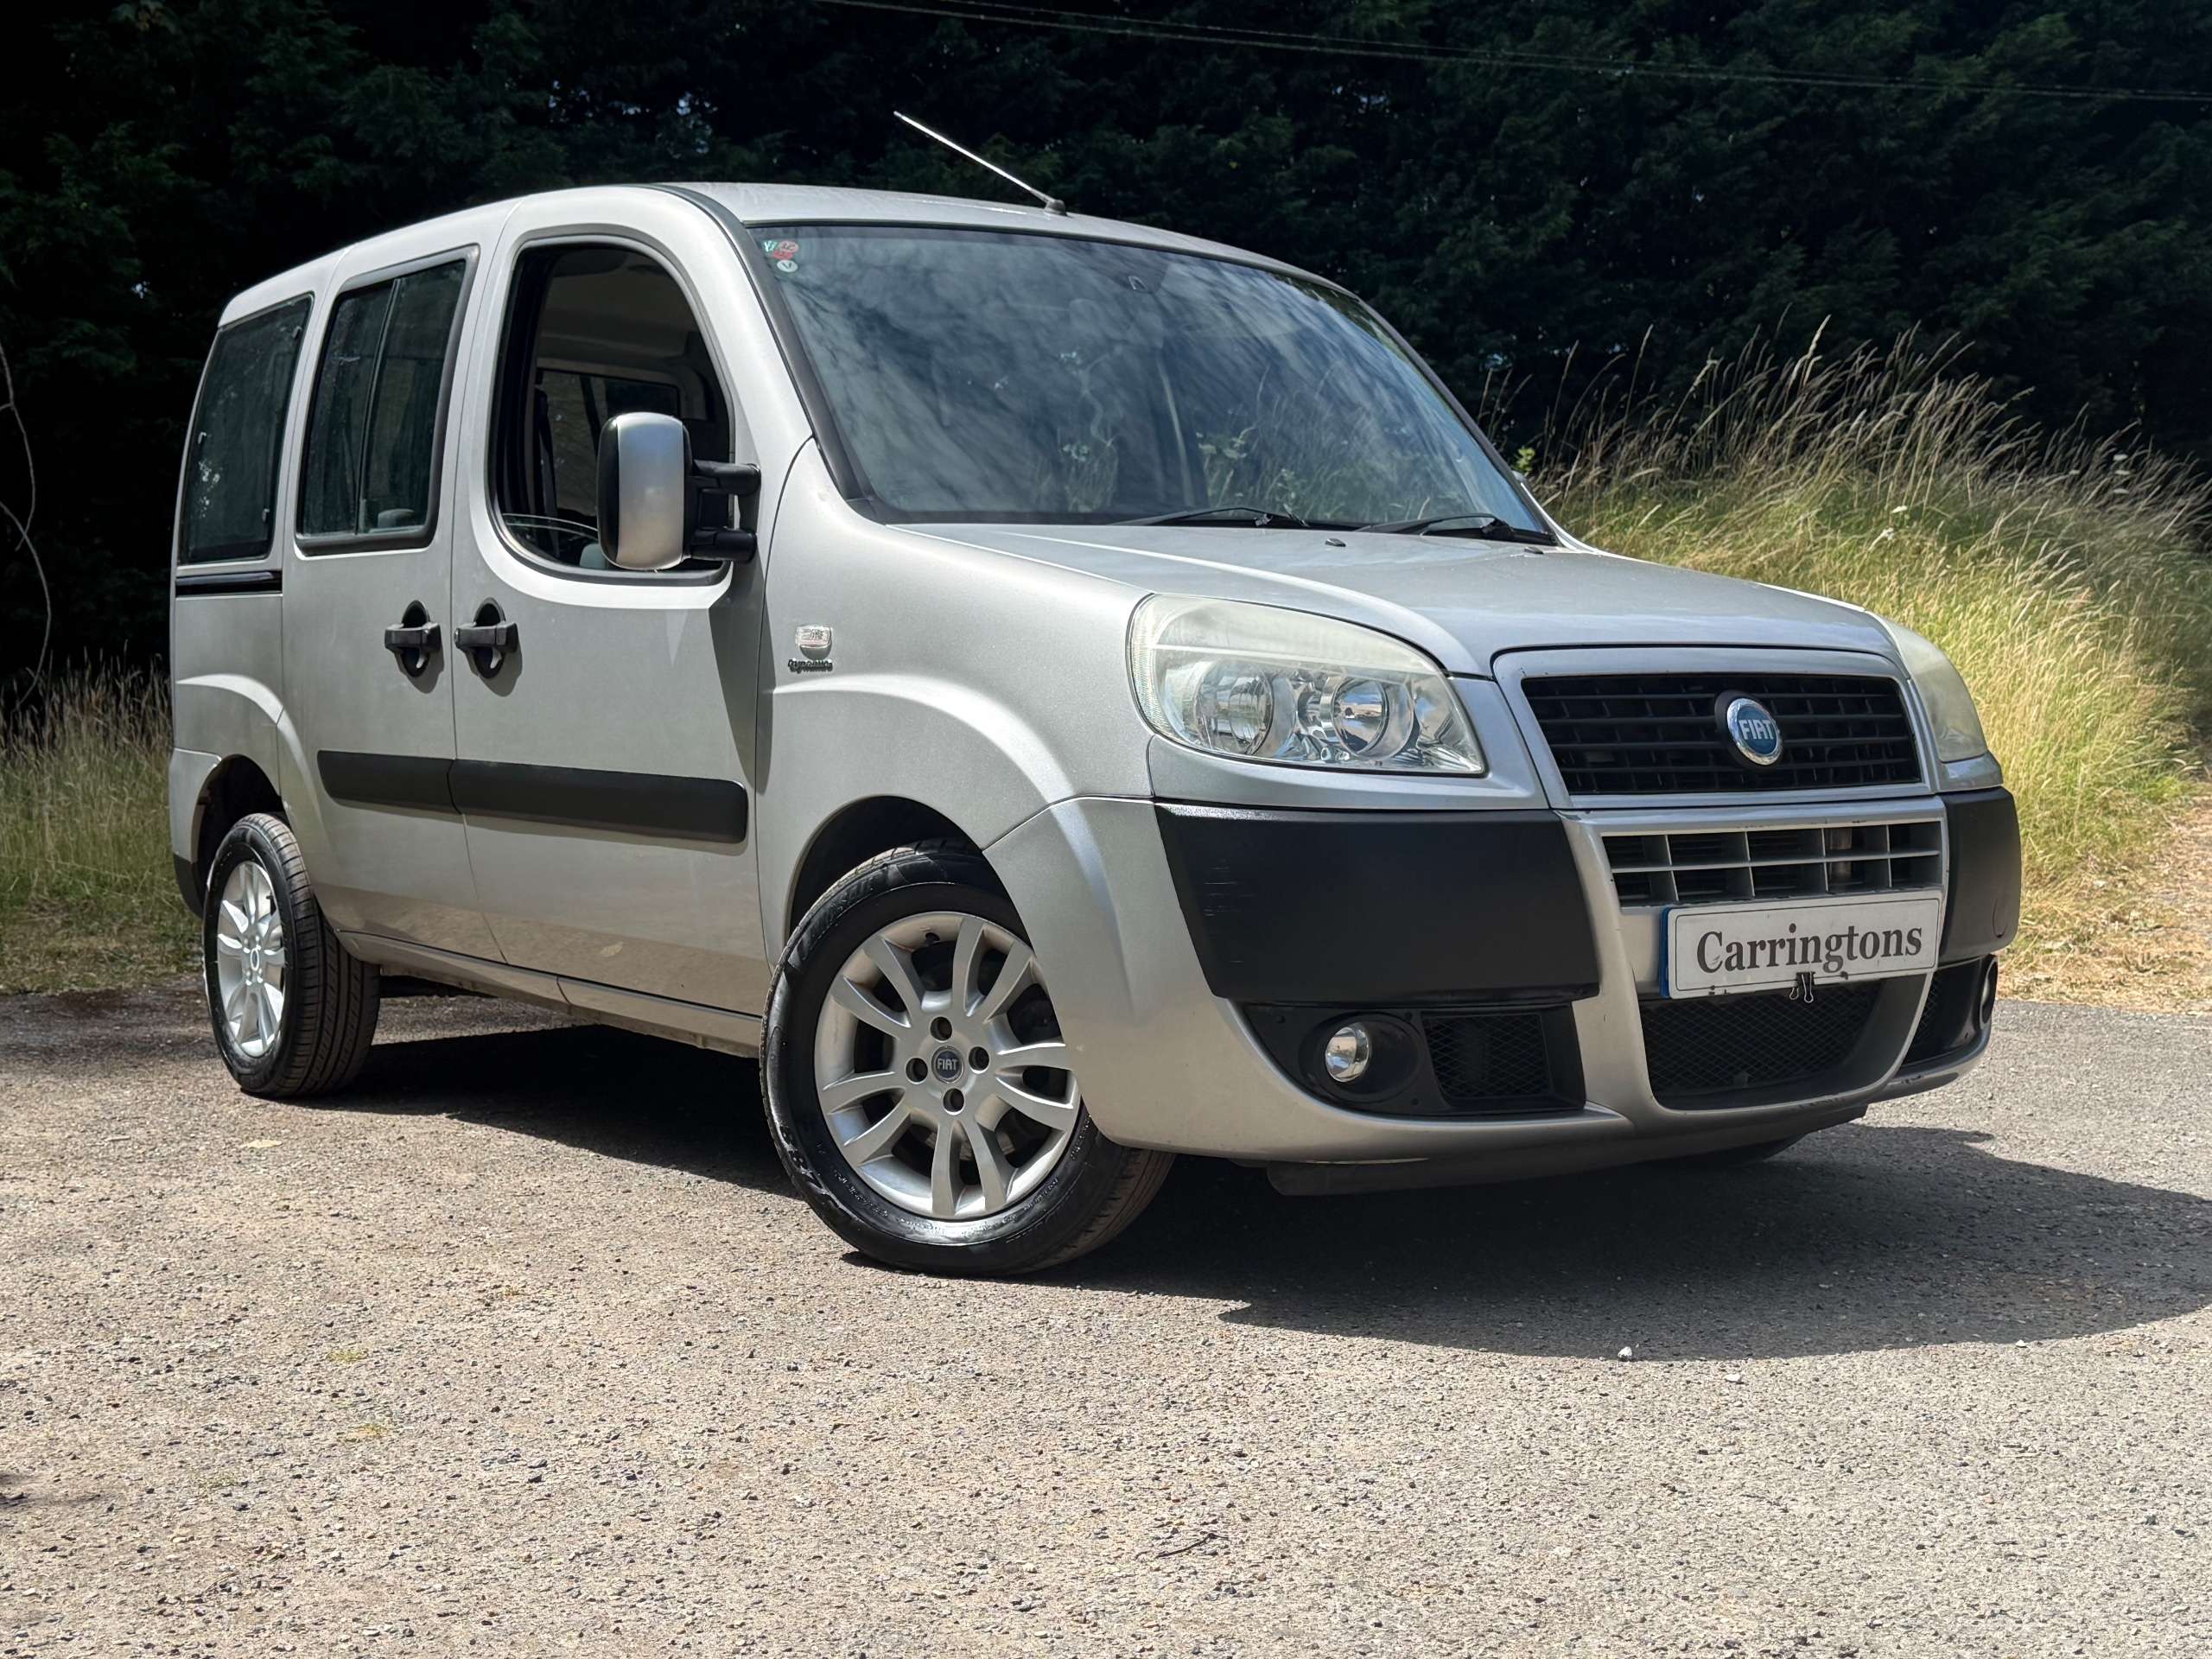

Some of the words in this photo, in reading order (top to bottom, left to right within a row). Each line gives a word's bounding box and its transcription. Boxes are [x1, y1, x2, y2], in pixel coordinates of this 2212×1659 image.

[1738, 719, 1774, 741] FIAT
[1697, 923, 1923, 974] Carringtons
[937, 1058, 958, 1071] FIAT
